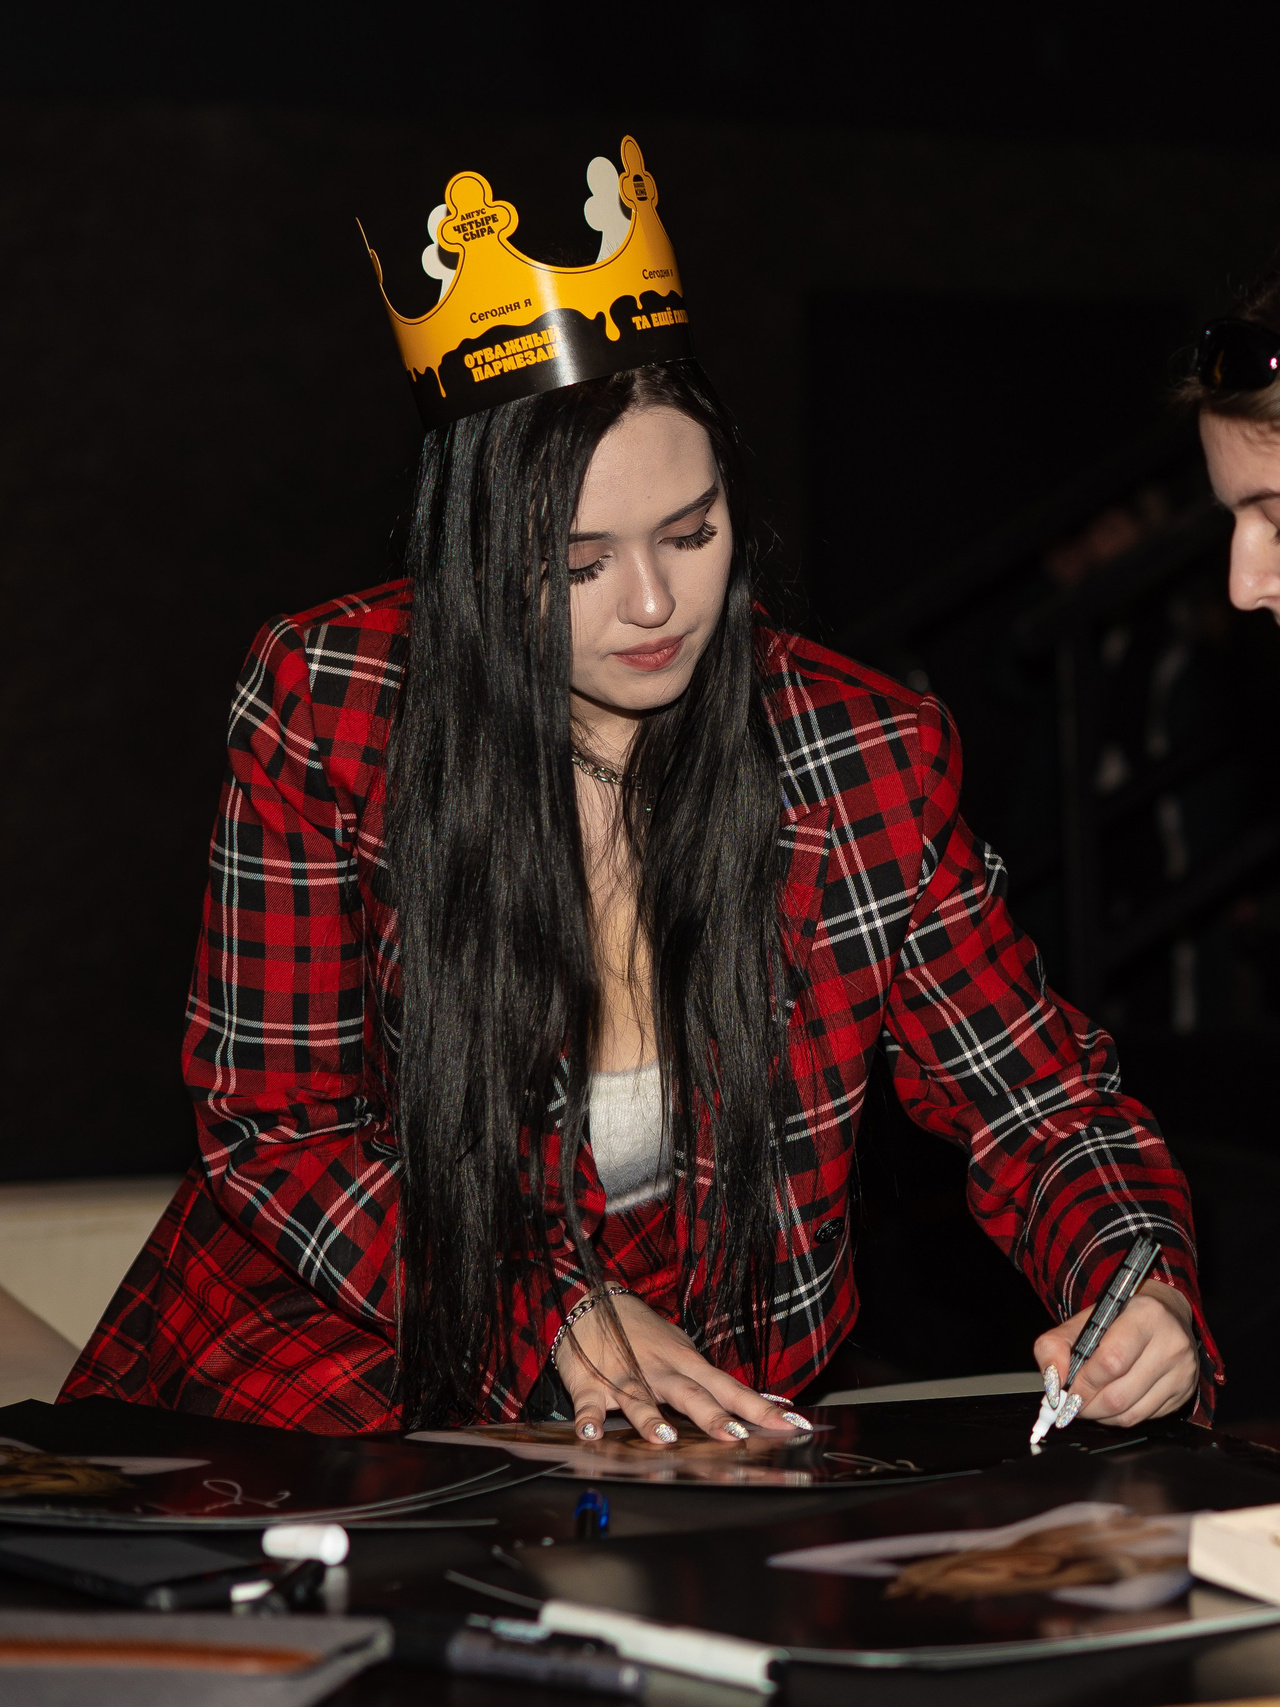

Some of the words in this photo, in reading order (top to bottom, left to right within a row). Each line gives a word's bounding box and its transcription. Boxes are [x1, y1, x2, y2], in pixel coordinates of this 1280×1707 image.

[453, 214, 499, 234] ЧЕТЫРЕ
[460, 208, 486, 221] АНГУС
[462, 226, 495, 242] СЫРА
[470, 301, 521, 324] Сегодня
[524, 298, 532, 308] я
[631, 315, 651, 331] ТА
[650, 307, 675, 328] ЕЩЁ
[464, 325, 562, 369] ОТВАЖНЫЙ
[471, 343, 562, 383] ПАРМЕЗАН
